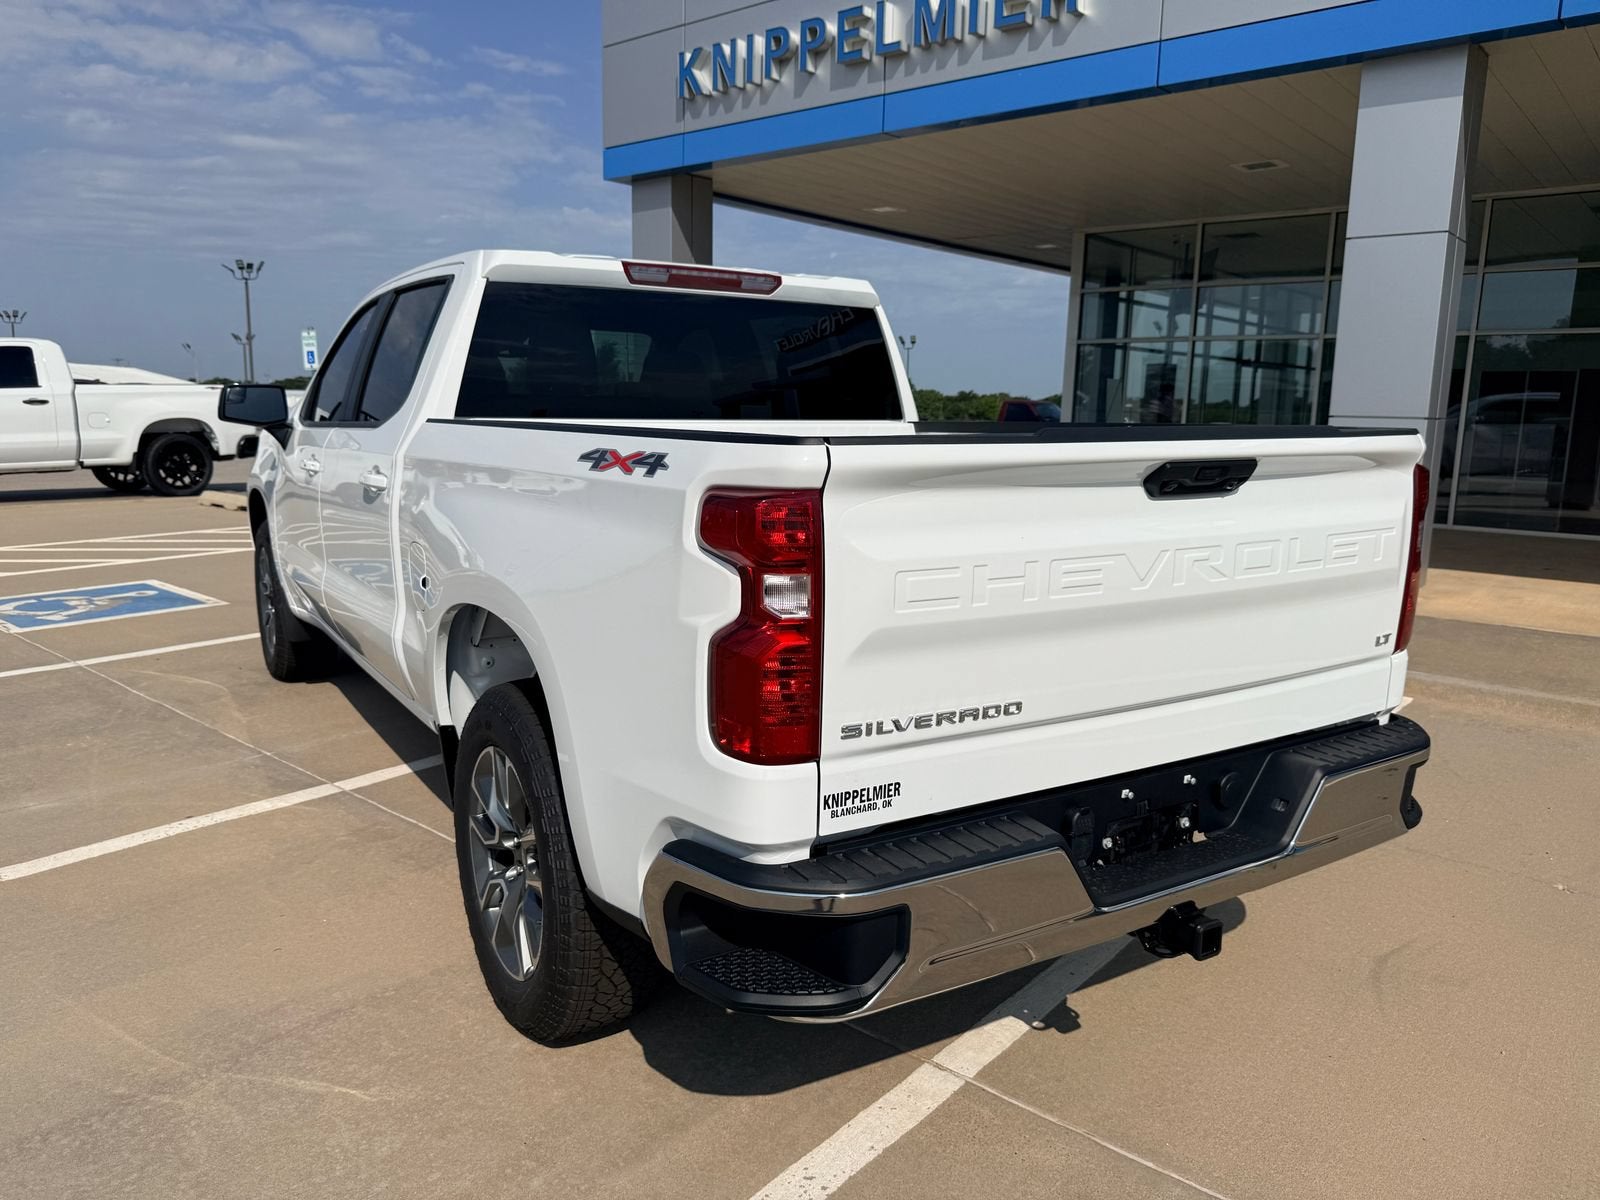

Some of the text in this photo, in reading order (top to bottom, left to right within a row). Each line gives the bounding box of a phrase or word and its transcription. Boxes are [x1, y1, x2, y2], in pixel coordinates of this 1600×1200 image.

[677, 0, 1083, 99] KNIPPELMI
[894, 527, 1396, 613] CHEVROLET
[1375, 633, 1392, 647] LT
[840, 701, 1023, 740] SILVERADO
[823, 782, 901, 810] KNIPPELMIER
[831, 799, 893, 819] BLANCHARD, OK
